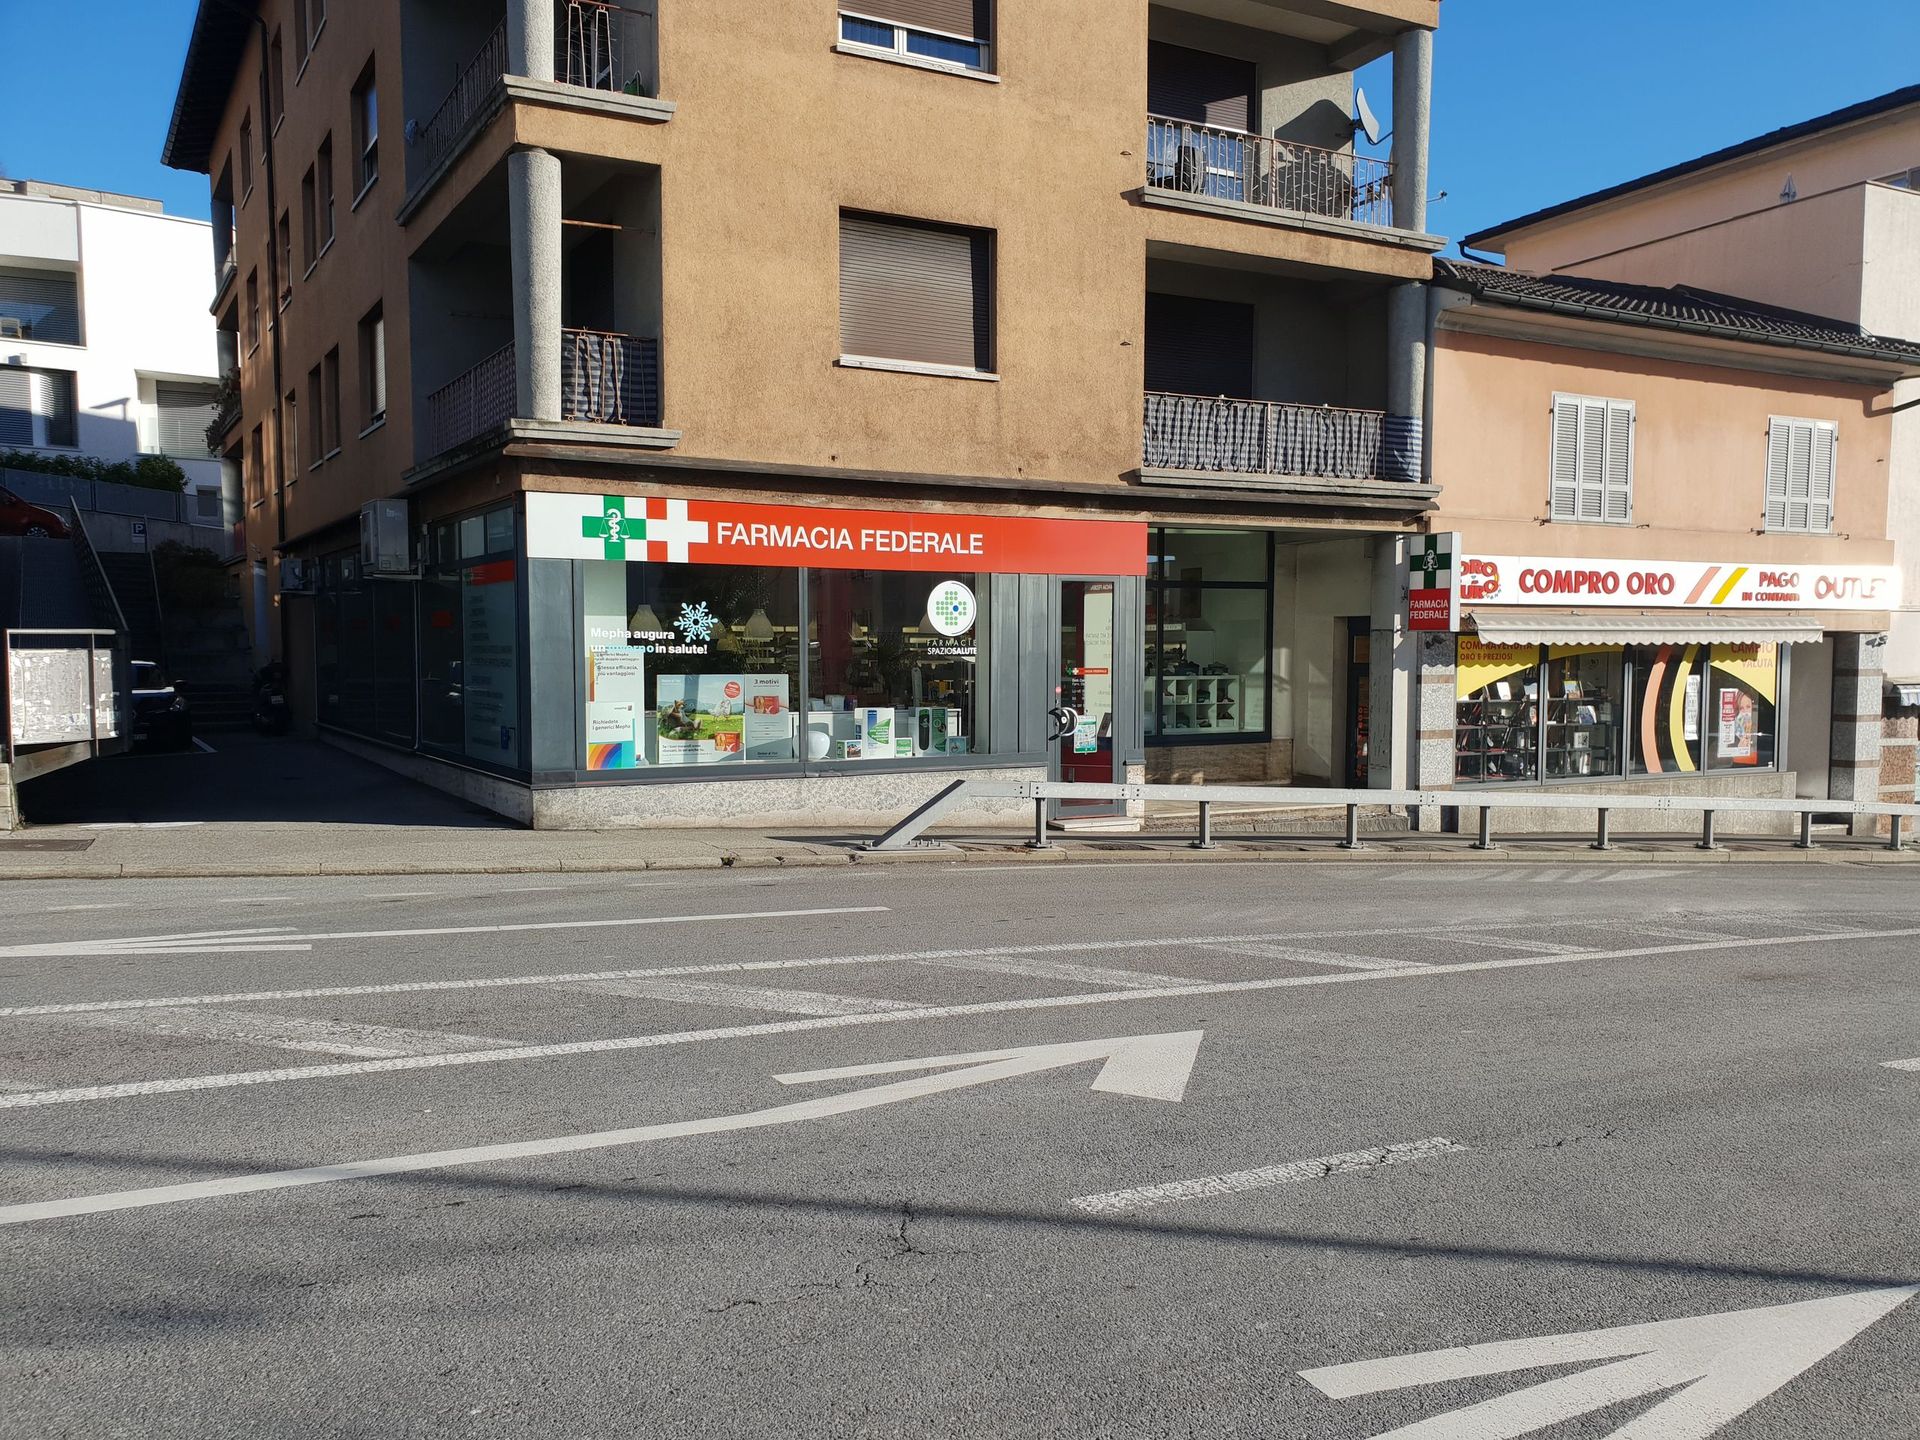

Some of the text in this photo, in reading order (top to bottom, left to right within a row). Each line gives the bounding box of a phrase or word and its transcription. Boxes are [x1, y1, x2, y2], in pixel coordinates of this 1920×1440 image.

[136, 524, 144, 533] P
[717, 522, 984, 555] FARMACIA FEDERALE
[1519, 569, 1620, 594] COMPRO
[1626, 571, 1675, 595] ORO
[1758, 571, 1800, 588] PAGO
[1741, 592, 1800, 602] IN CONTANTI
[1410, 600, 1449, 609] FARMACIA
[1410, 610, 1449, 619] FEDERALE
[590, 628, 675, 640] Mepha augura
[927, 639, 977, 647] FARMACIE
[655, 644, 667, 654] in
[668, 644, 708, 655] salute!
[927, 647, 977, 655] SPAZIOSALUTE
[1460, 653, 1485, 661] ORO
[1742, 658, 1774, 668] VALUTA
